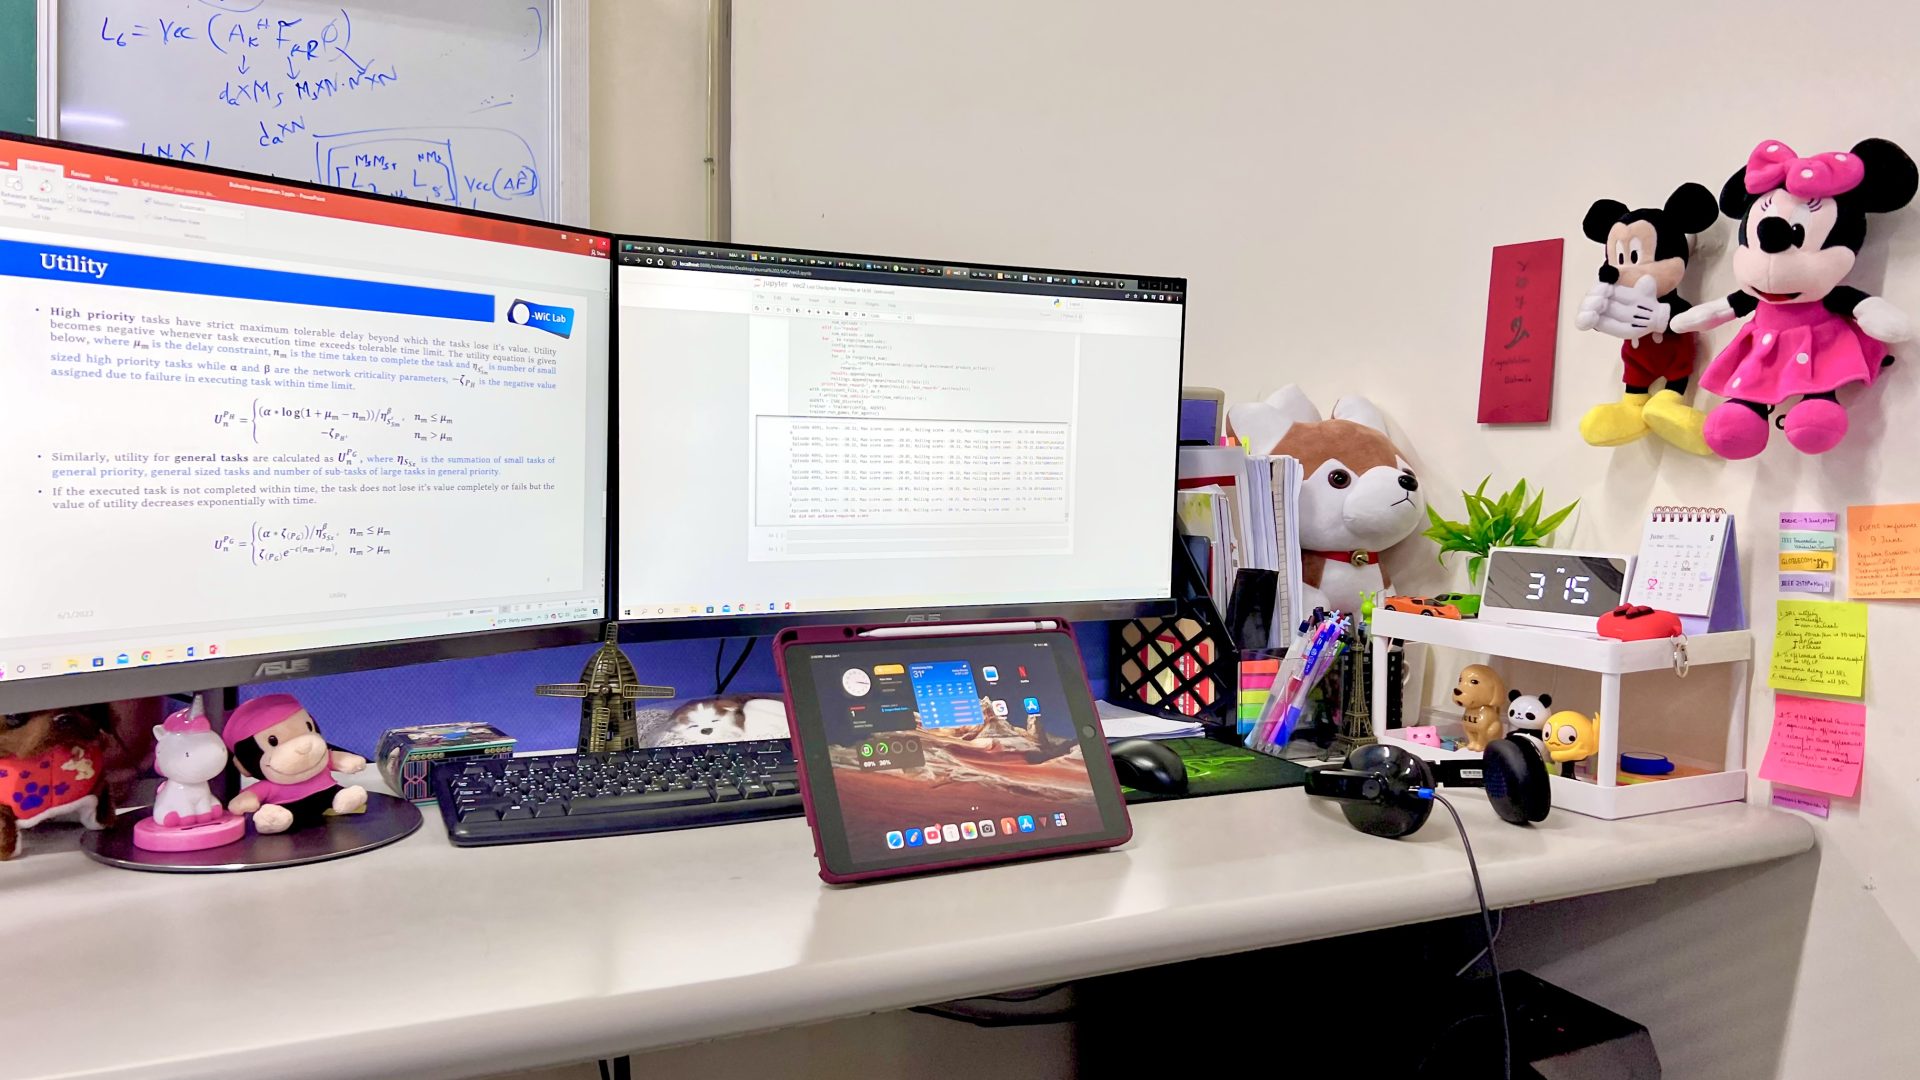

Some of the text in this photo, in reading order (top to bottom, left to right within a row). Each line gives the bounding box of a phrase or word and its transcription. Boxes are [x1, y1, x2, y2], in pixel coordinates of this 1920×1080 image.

[40, 253, 109, 279] Utility
[552, 313, 567, 323] Lab
[50, 307, 80, 319] High
[86, 311, 135, 324] priority
[141, 315, 170, 325] tasks
[175, 317, 200, 327] have
[206, 321, 234, 330] strict
[239, 324, 288, 334] maximum
[294, 327, 334, 338] tolerable
[339, 330, 362, 342] delay
[368, 333, 399, 344] beyond
[403, 336, 428, 345] which
[432, 338, 446, 346] the
[450, 339, 470, 348] tasks
[473, 340, 488, 349] lose
[534, 345, 556, 357] Utility
[50, 320, 100, 332] becomes
[106, 327, 154, 336] negative
[160, 329, 212, 340] whenever
[216, 333, 238, 341] task
[242, 336, 290, 345] execution
[294, 338, 315, 347] time
[319, 342, 355, 350] exceeds
[358, 343, 396, 353] tolerable
[400, 346, 420, 354] time
[448, 349, 462, 357] The
[466, 351, 489, 361] utility
[492, 354, 524, 362] equation
[528, 355, 534, 363] is
[536, 356, 556, 365] given
[93, 336, 130, 346] where
[152, 339, 161, 348] is
[164, 340, 182, 349] the
[184, 341, 214, 353] delay
[290, 348, 298, 356] is
[300, 349, 316, 358] the
[319, 350, 338, 359] time
[342, 352, 366, 361] taken
[370, 354, 378, 362] to
[380, 356, 418, 366] complete
[421, 358, 434, 366] the
[436, 359, 453, 367] task
[456, 360, 470, 368] and
[488, 362, 496, 370] is
[498, 364, 524, 372] number
[526, 365, 536, 373] of
[50, 352, 80, 362] sized
[86, 354, 112, 365] high
[116, 356, 160, 368] priority
[164, 359, 192, 368] tasks
[196, 361, 226, 370] while
[241, 364, 260, 372] and
[294, 366, 308, 374] the
[312, 368, 350, 377] network
[354, 370, 396, 381] criticality
[478, 377, 486, 385] is
[488, 378, 500, 386] the
[502, 380, 534, 388] negative
[537, 381, 556, 389] value
[50, 368, 102, 378] assigned
[105, 370, 126, 379] due
[144, 372, 181, 382] failure
[184, 374, 195, 382] in
[198, 377, 248, 387] executing
[250, 378, 271, 386] task
[274, 379, 305, 387] within
[307, 380, 328, 388] time
[114, 452, 148, 463] utility
[153, 452, 170, 461] for
[174, 453, 216, 463] general
[220, 453, 248, 462] tasks
[272, 454, 320, 462] calculated
[366, 455, 394, 463] where
[420, 455, 429, 463] is
[431, 455, 444, 463] the
[51, 467, 96, 478] general
[150, 467, 191, 478] general
[194, 467, 220, 475] sized
[224, 467, 250, 475] tasks
[252, 467, 270, 475] and
[273, 467, 310, 475] number
[312, 467, 322, 475] of
[324, 467, 367, 475] sub-tasks
[368, 467, 378, 475] of
[380, 467, 402, 477] large
[403, 467, 426, 475] tasks
[427, 467, 436, 475] in
[437, 467, 468, 477] general
[52, 486, 62, 495] If
[66, 486, 84, 495] the
[88, 486, 140, 495] executed
[143, 486, 167, 494] task
[170, 486, 180, 494] is
[182, 486, 200, 494] not
[203, 485, 256, 495] completed
[259, 485, 291, 493] within
[320, 484, 336, 492] the
[338, 484, 358, 492] task
[359, 484, 380, 492] does
[382, 484, 396, 492] not
[398, 483, 416, 491] lose
[433, 483, 454, 491] value
[456, 482, 498, 492] completely
[510, 482, 528, 490] fails
[529, 481, 542, 490] but
[542, 481, 555, 489] the
[52, 500, 84, 508] value
[88, 500, 100, 508] of
[102, 499, 138, 509] utility
[140, 499, 194, 507] decreases
[196, 497, 265, 508] exponentially
[268, 497, 290, 505] with
[905, 612, 941, 623] ASUS
[255, 658, 310, 676] ASUS
